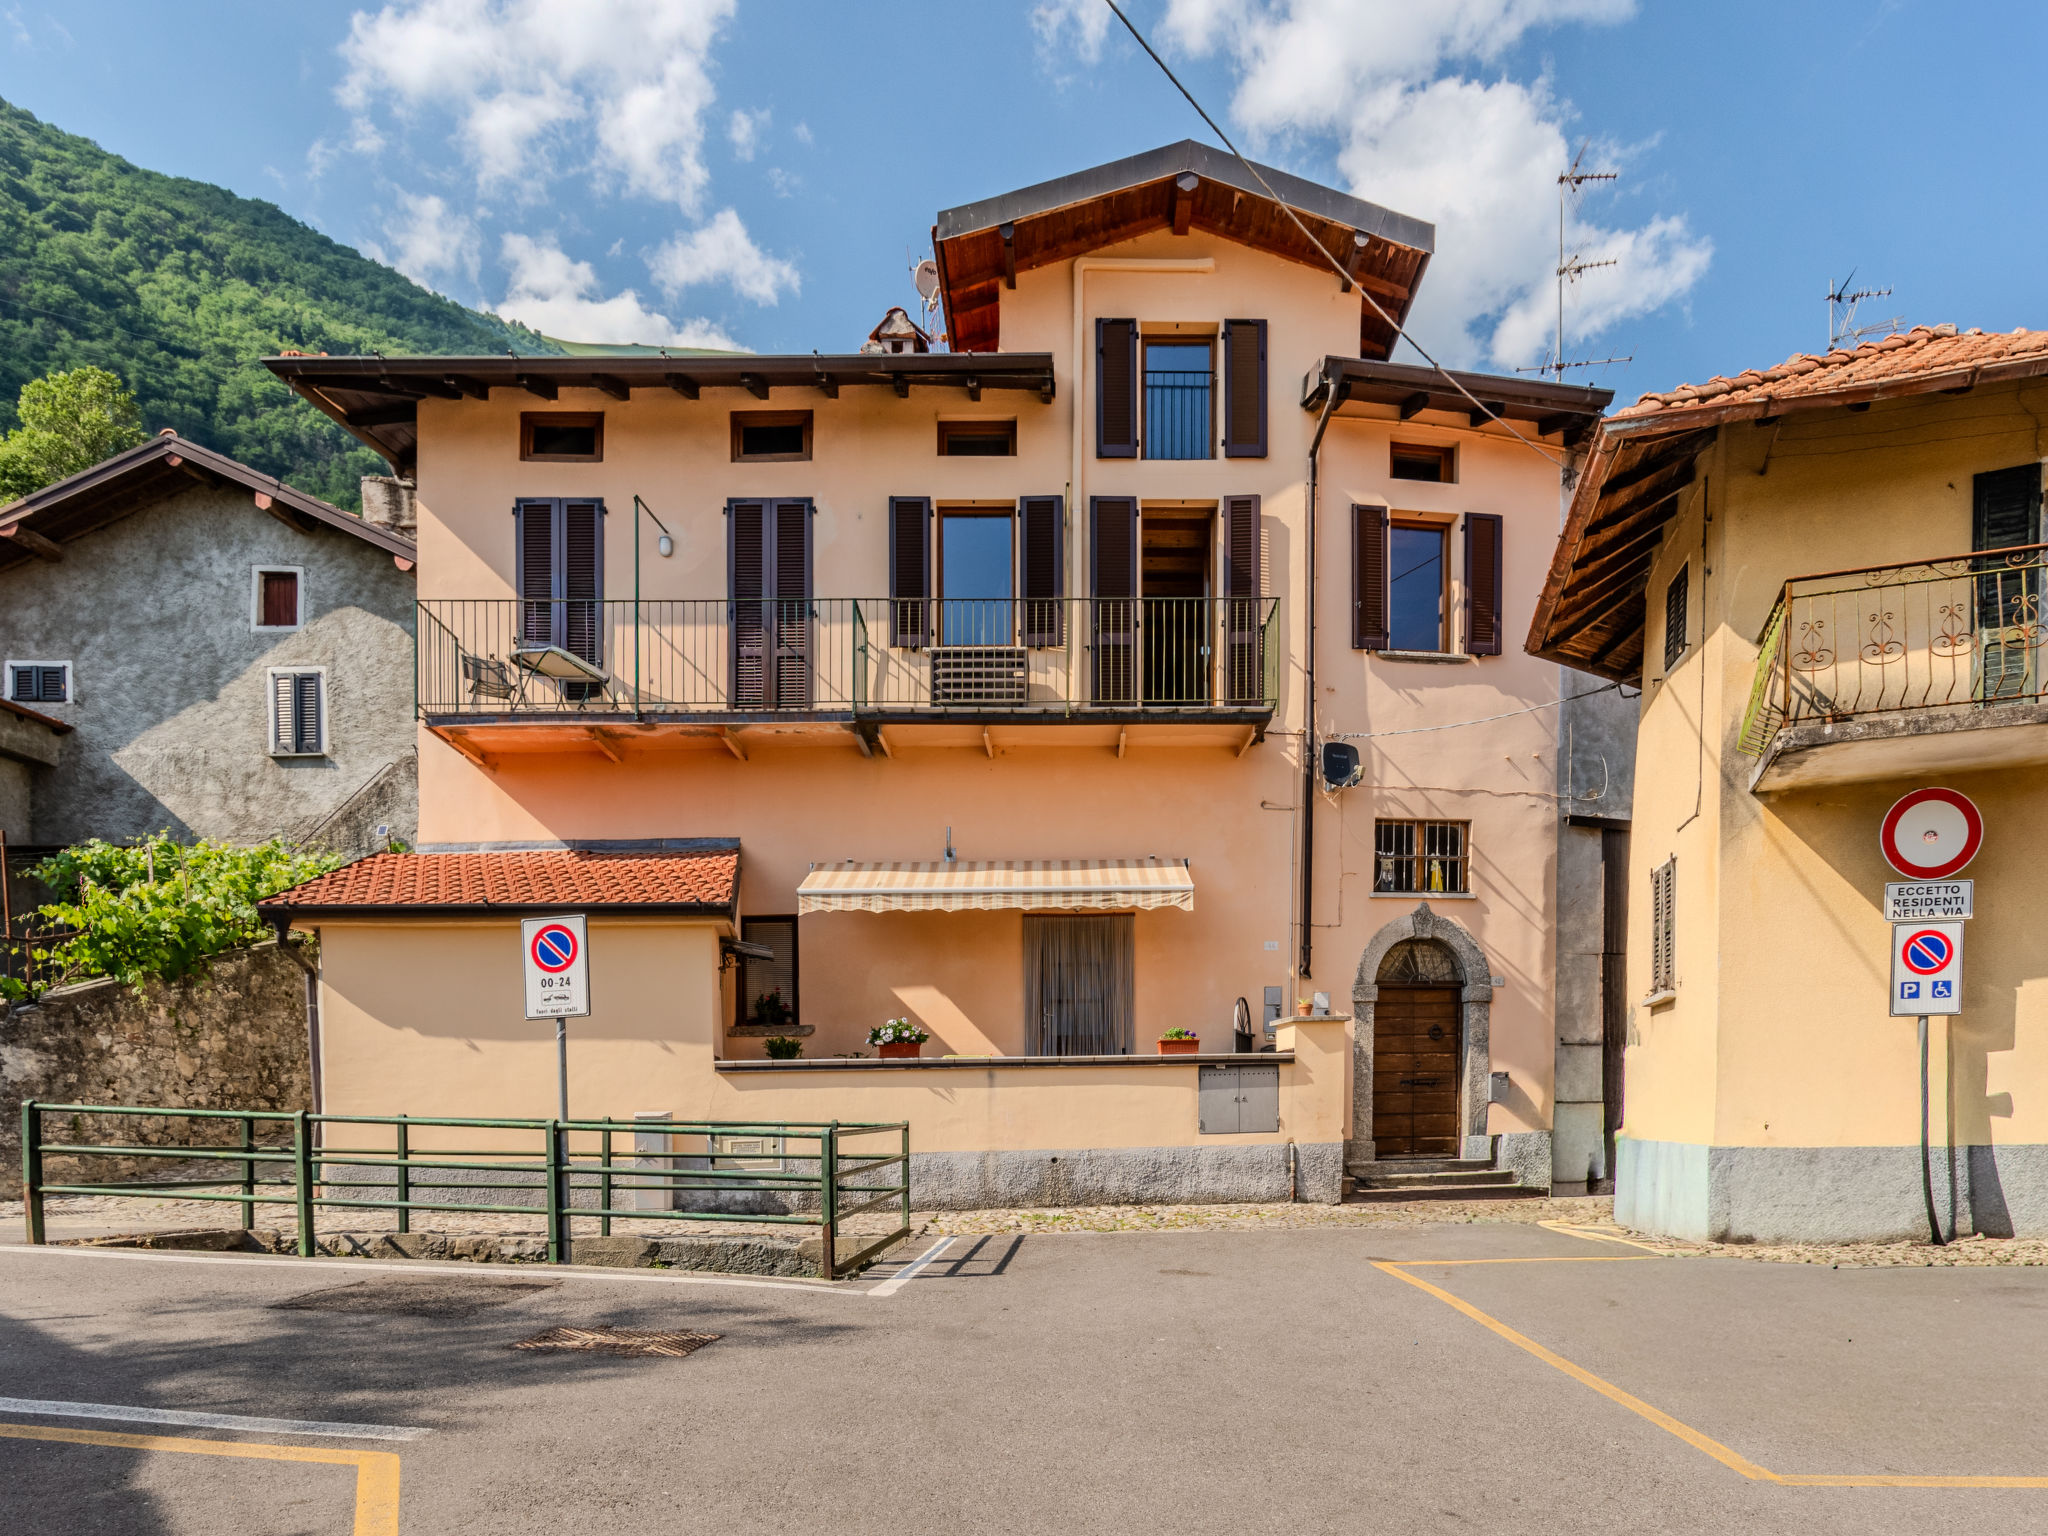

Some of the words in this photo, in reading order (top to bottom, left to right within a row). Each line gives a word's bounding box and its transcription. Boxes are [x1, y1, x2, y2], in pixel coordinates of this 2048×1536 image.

[1898, 885, 1960, 896] ECCETTO
[1893, 896, 1964, 907] RESIDENTI
[1892, 908, 1935, 918] NELLA
[1942, 907, 1963, 916] VIA
[1903, 983, 1917, 998] P
